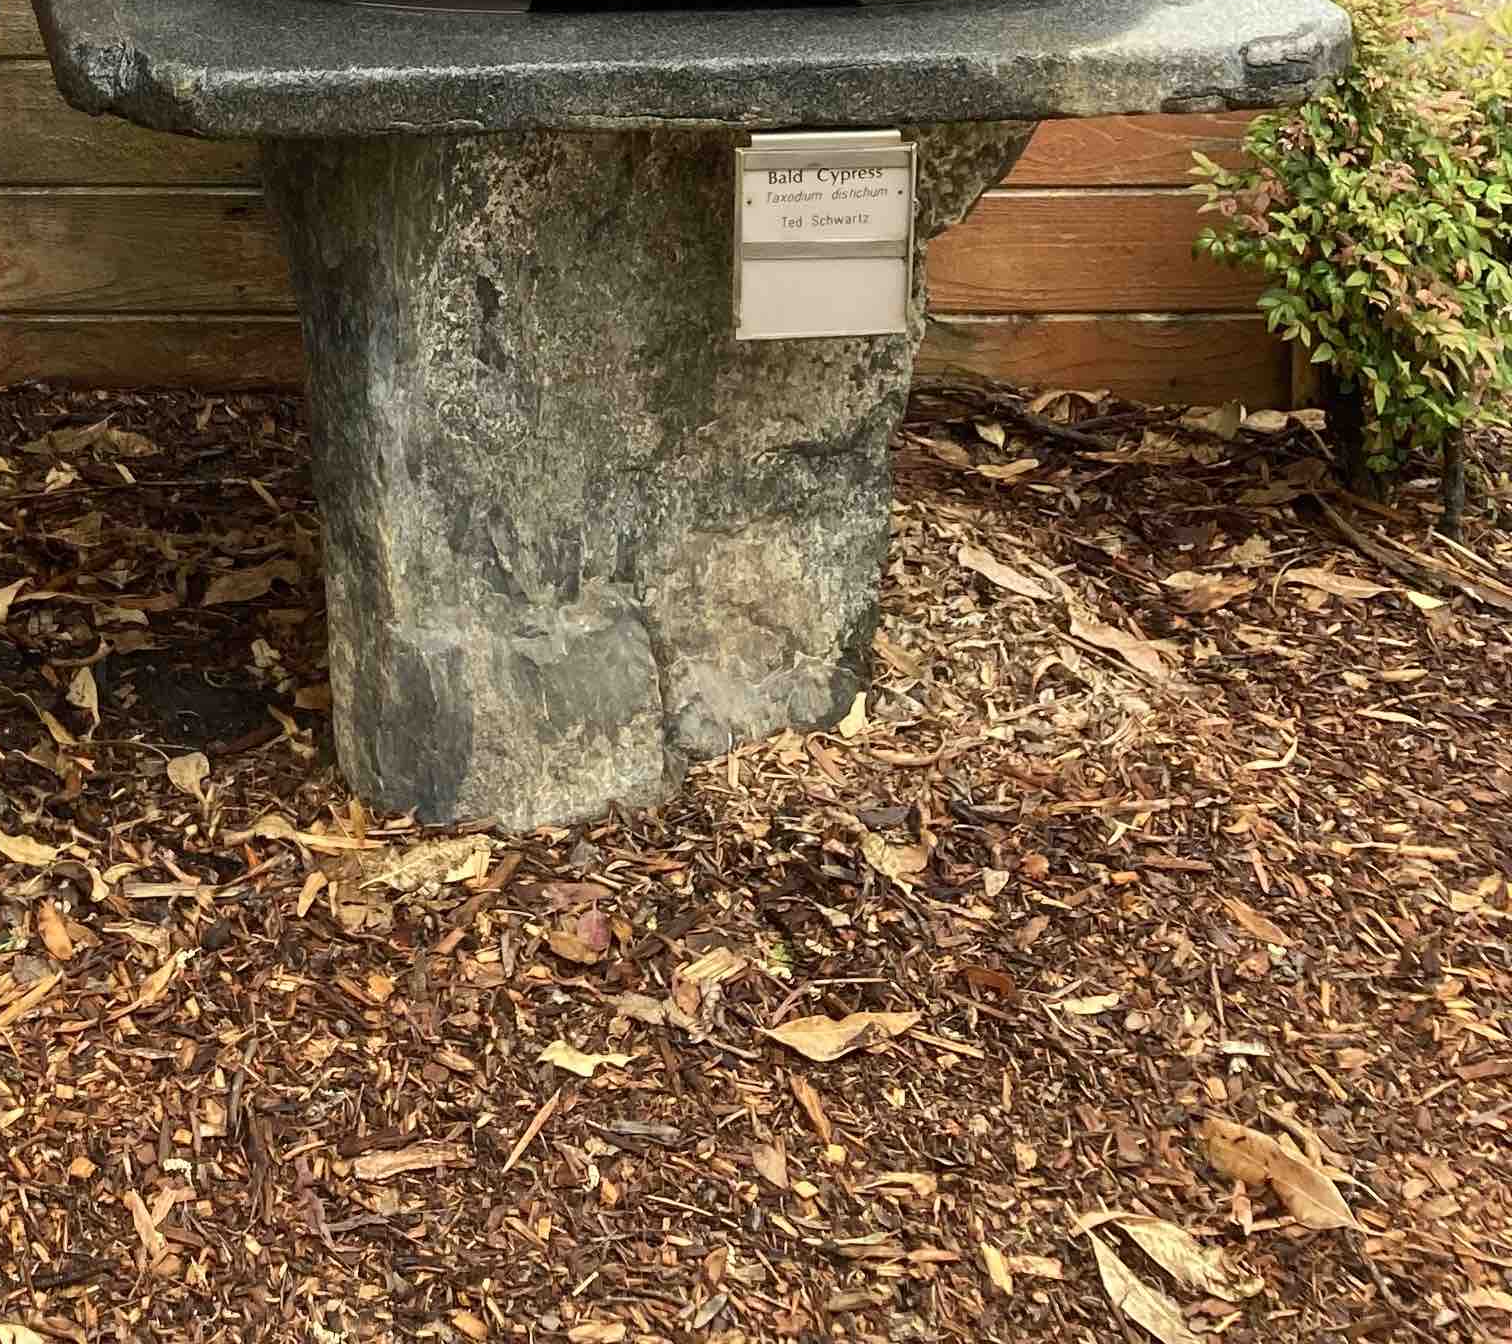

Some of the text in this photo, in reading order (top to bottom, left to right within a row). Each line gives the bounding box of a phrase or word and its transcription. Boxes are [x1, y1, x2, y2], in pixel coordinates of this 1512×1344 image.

[768, 168, 882, 185] Bald Cypress
[782, 216, 802, 228] Ted
